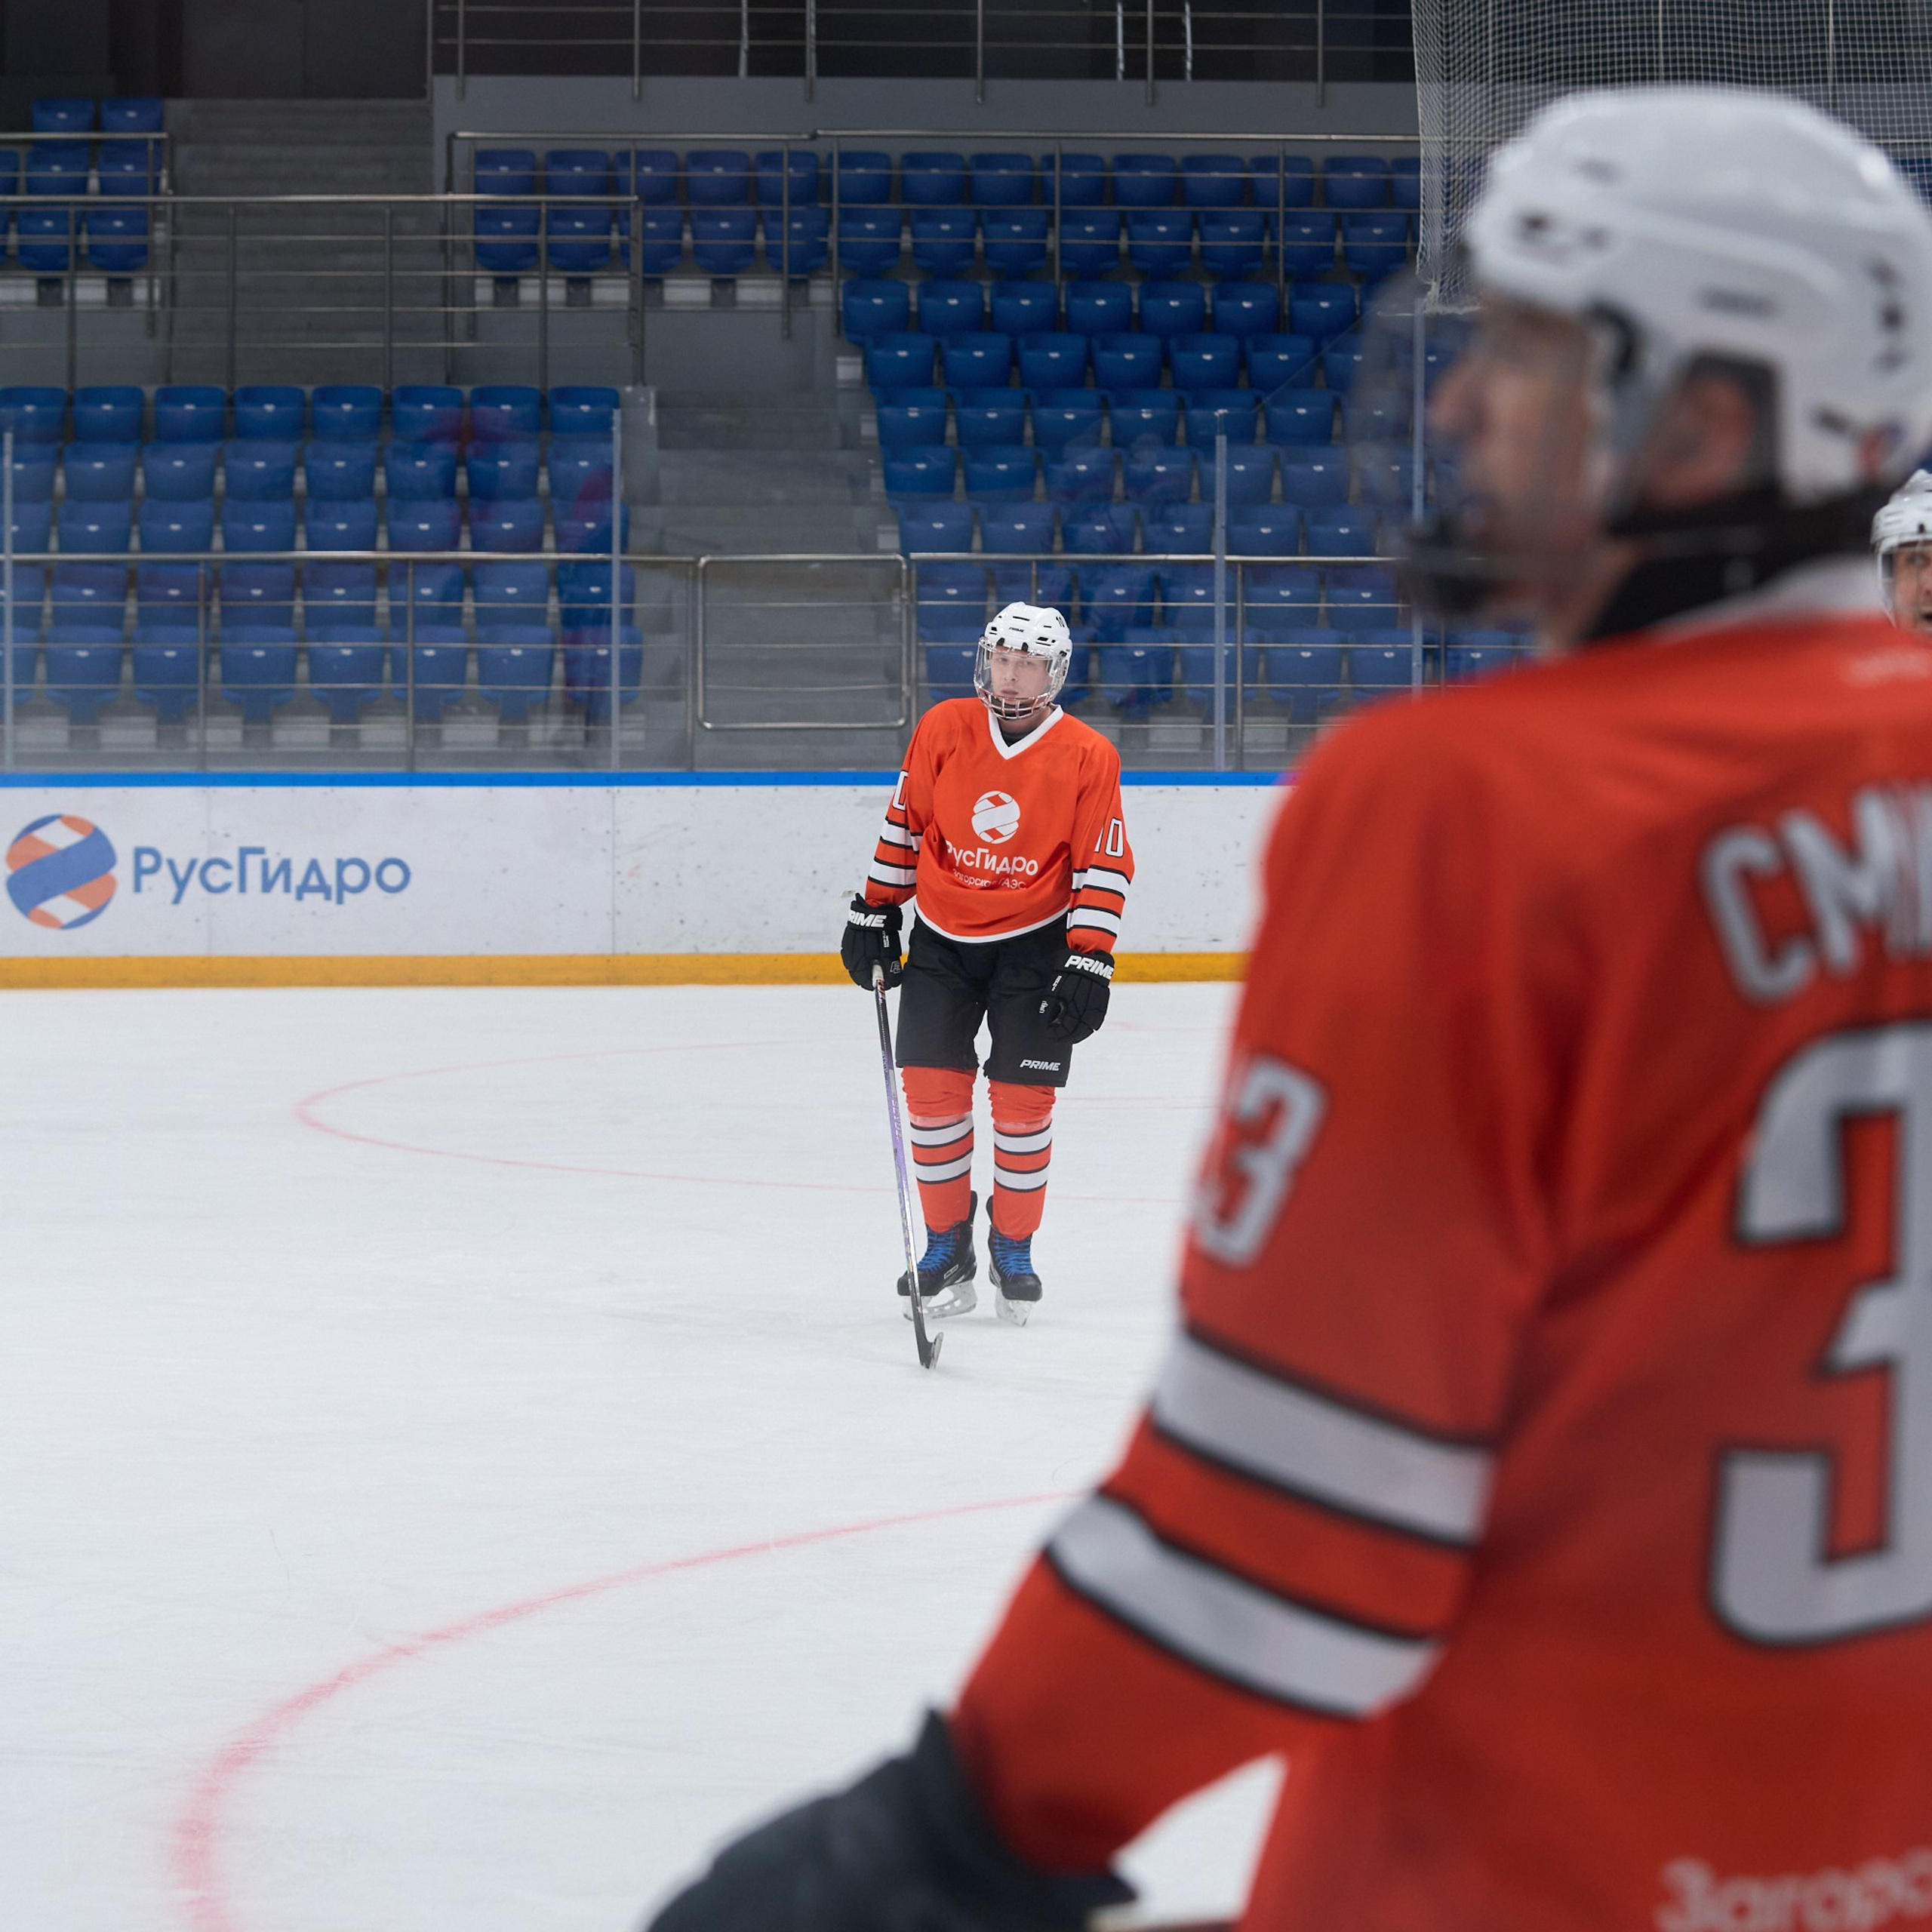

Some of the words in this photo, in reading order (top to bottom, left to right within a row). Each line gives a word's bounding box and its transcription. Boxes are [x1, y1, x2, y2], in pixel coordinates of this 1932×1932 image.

[132, 846, 411, 905] РусГидро
[848, 910, 888, 928] RIME
[1064, 955, 1115, 980] PRIME
[1020, 1059, 1061, 1072] PRIME
